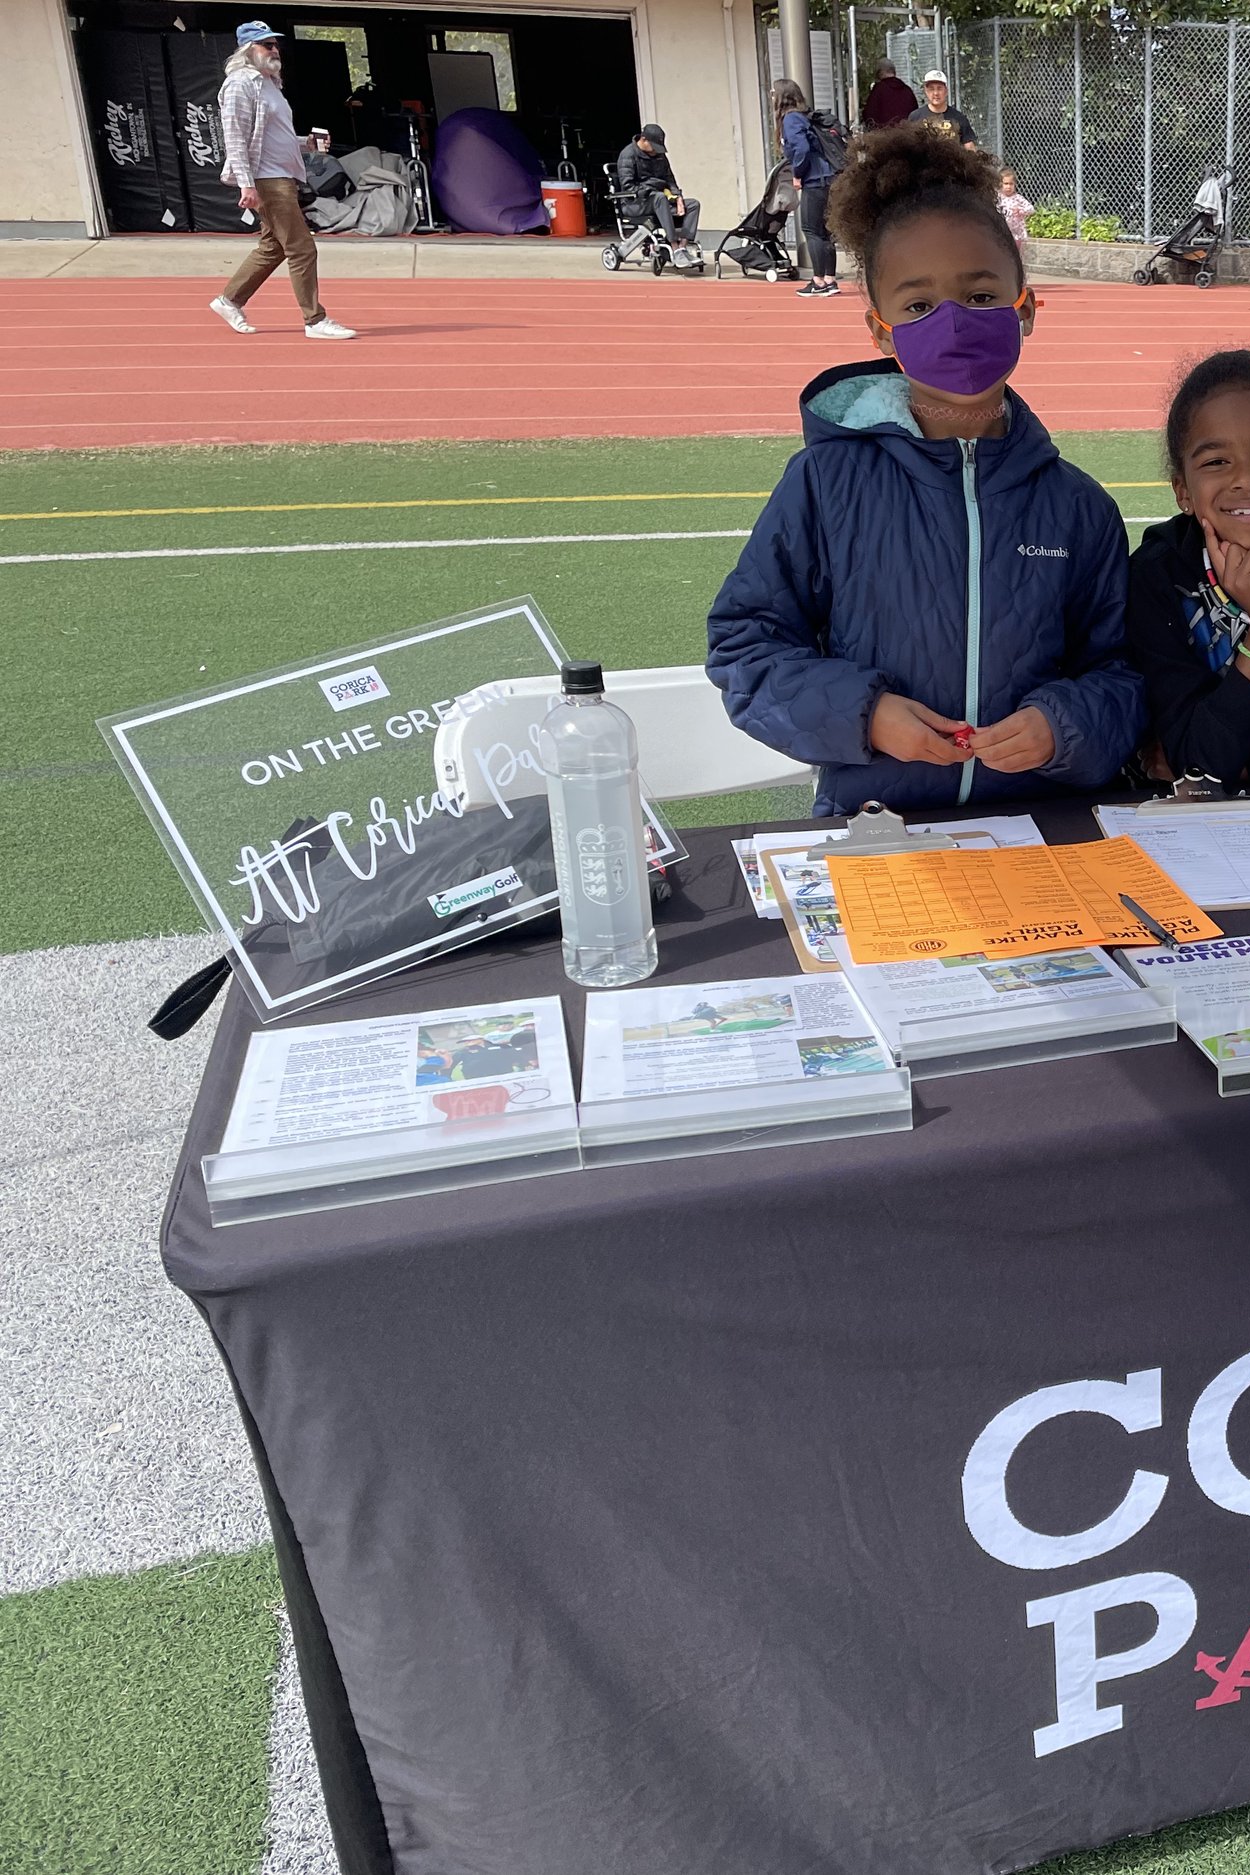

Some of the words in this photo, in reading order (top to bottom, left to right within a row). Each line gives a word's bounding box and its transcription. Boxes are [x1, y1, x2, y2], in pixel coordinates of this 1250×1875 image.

[104, 100, 136, 166] Richey
[184, 101, 216, 167] Richey
[1026, 545, 1069, 559] Columb
[330, 675, 375, 694] CORICA
[241, 749, 303, 785] ON
[302, 724, 382, 766] THE
[385, 684, 509, 739] GREEN
[327, 790, 464, 881] Corica
[1021, 920, 1077, 928] Scorecard
[1178, 918, 1192, 926] A
[983, 934, 1028, 945] LIKE
[1034, 929, 1084, 941] PLAY
[1136, 949, 1233, 966] YOUTH
